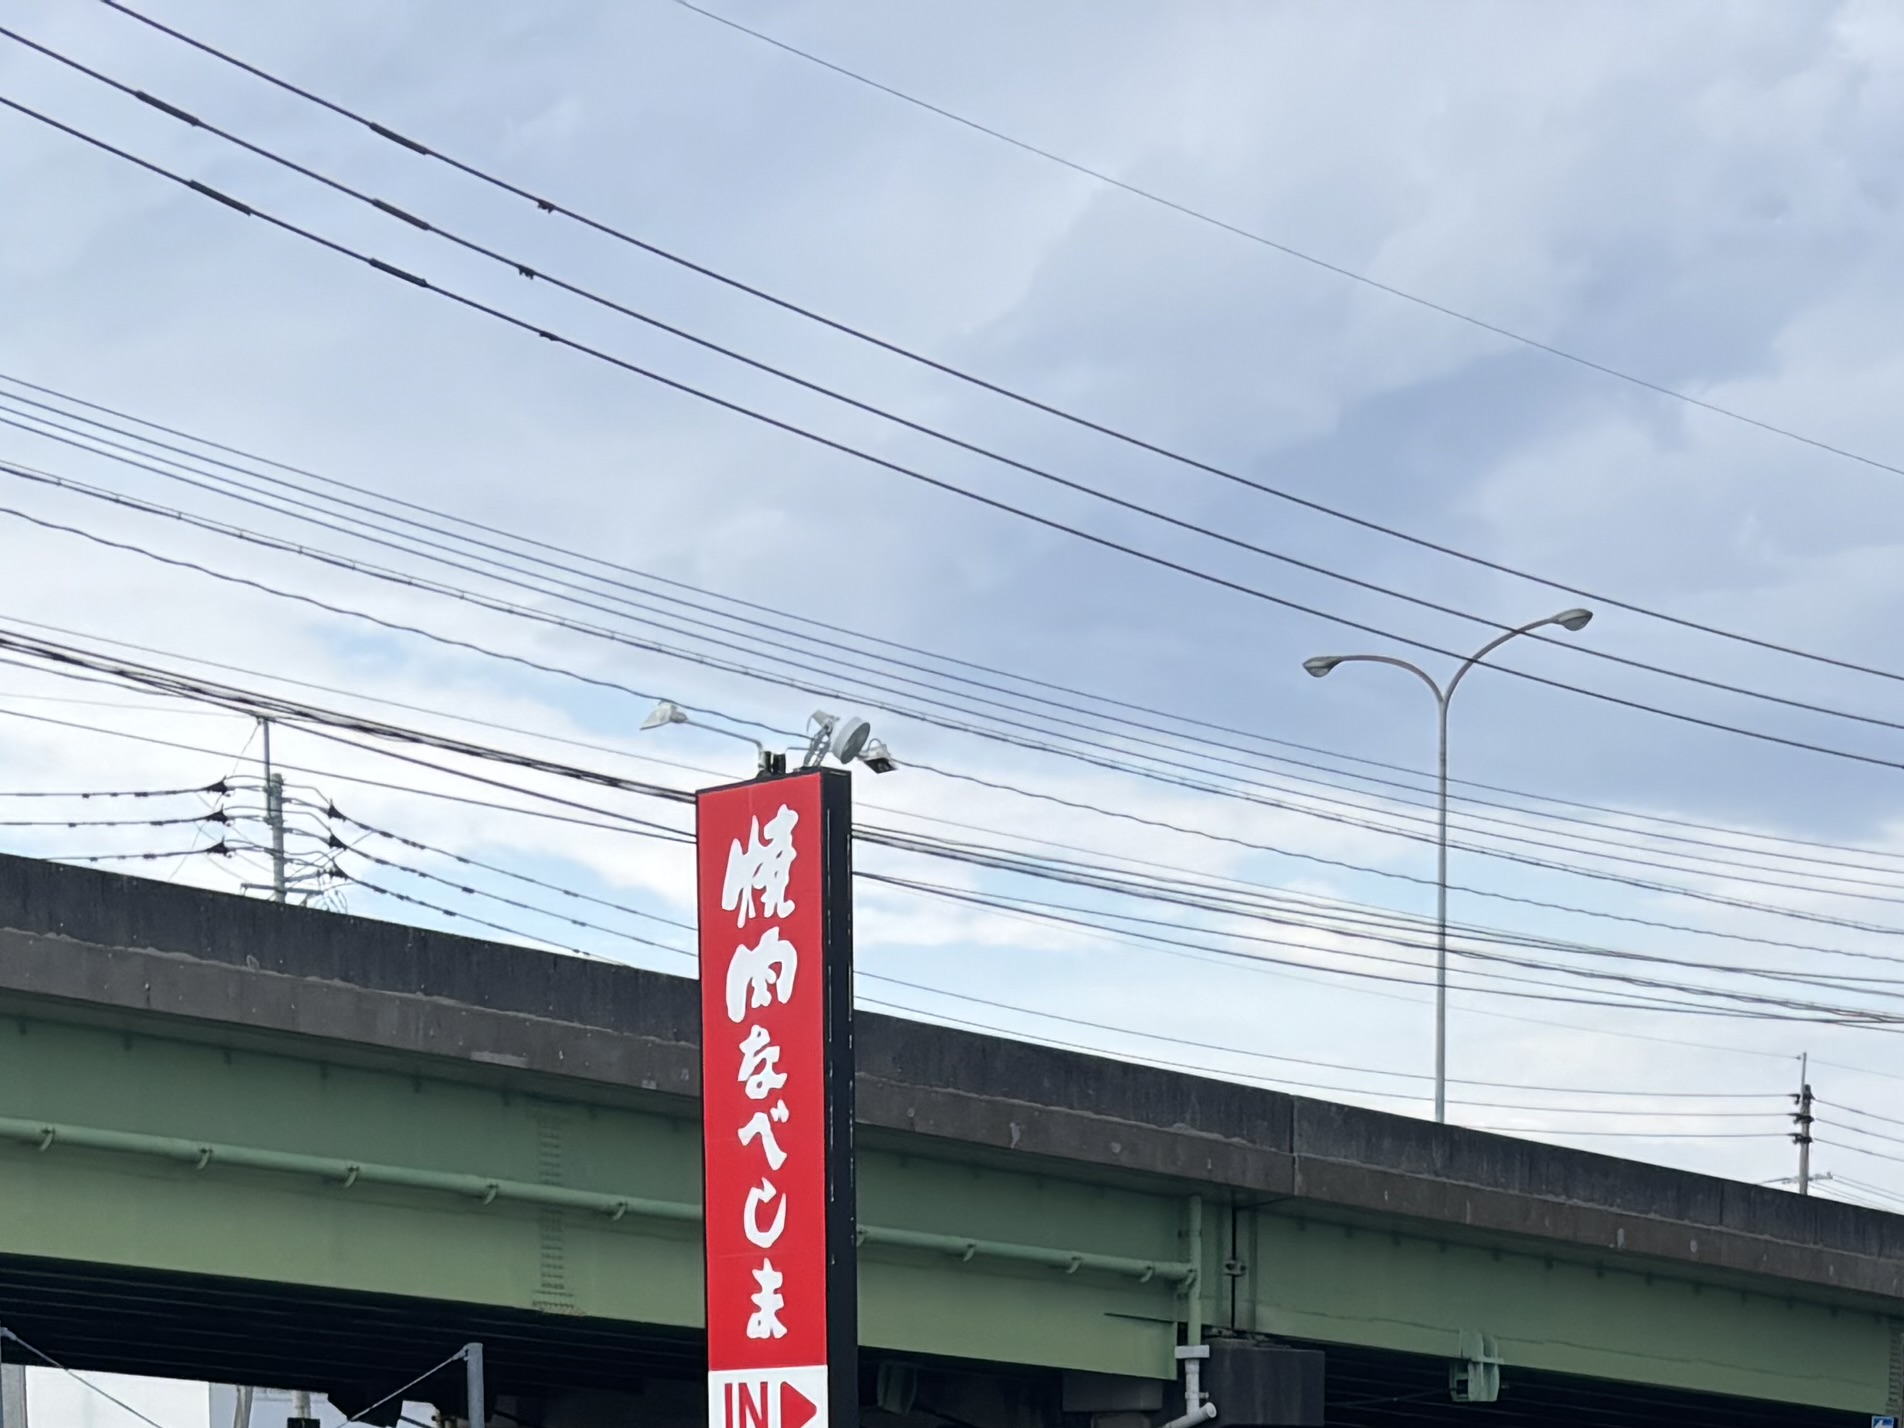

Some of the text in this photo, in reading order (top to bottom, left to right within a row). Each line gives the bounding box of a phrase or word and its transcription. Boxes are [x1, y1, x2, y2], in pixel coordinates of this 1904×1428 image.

[722, 804, 799, 1340] 焼肉なべしま
